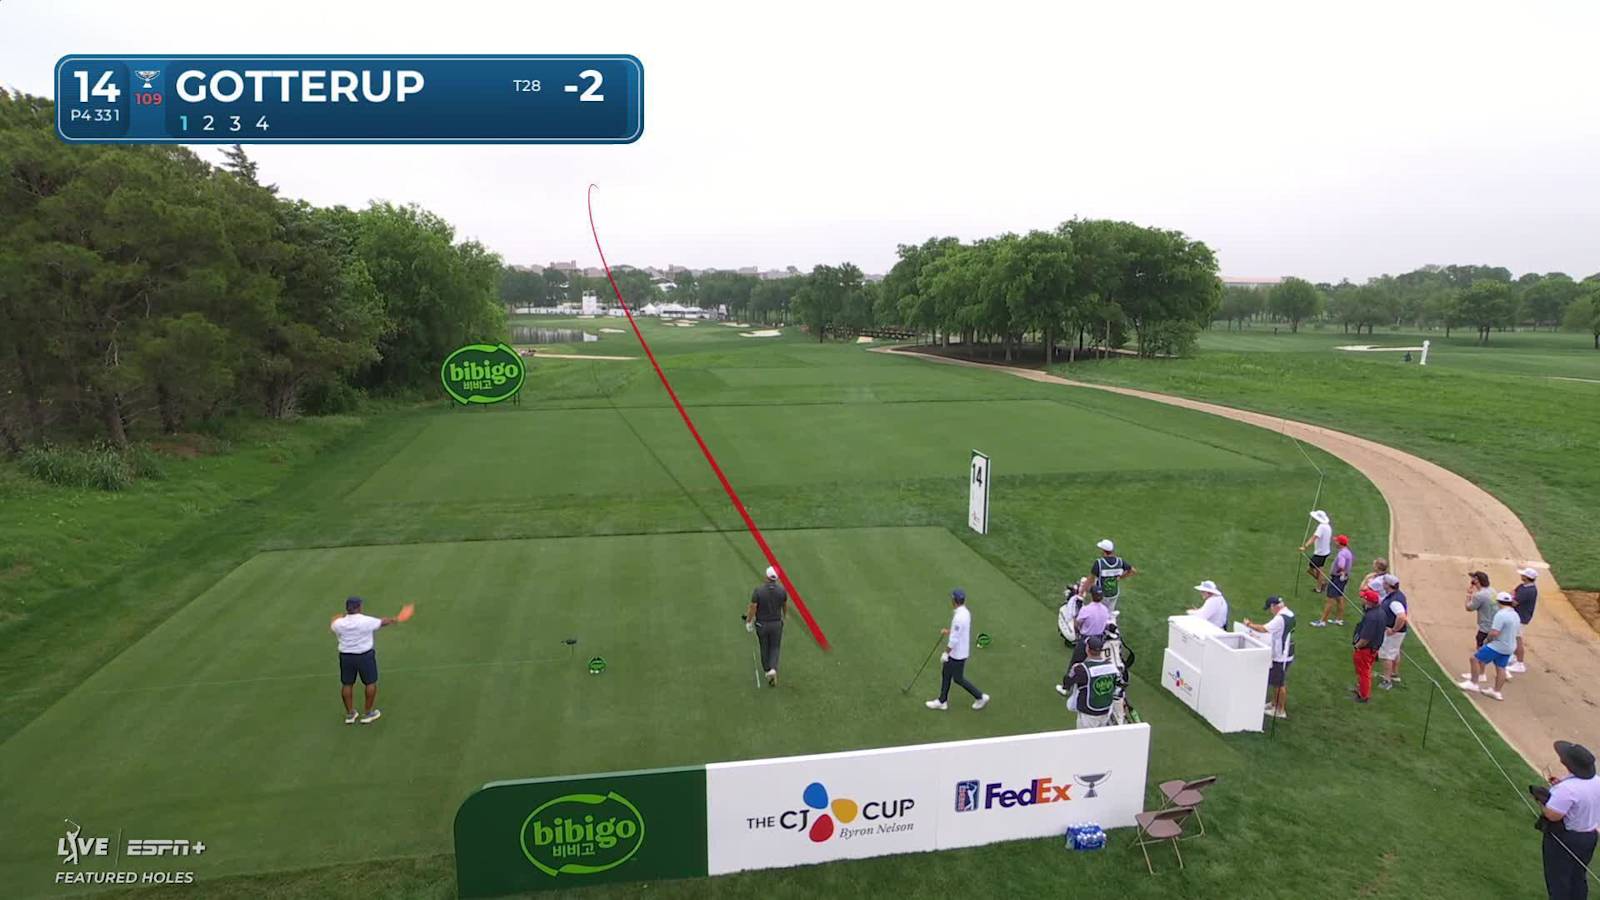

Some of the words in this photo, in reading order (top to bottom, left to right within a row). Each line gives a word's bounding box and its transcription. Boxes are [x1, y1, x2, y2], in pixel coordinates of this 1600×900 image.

[449, 359, 519, 385] bibigo
[464, 380, 492, 391] 비비고
[971, 463, 983, 487] 14
[984, 778, 1073, 809] FedEx
[746, 815, 776, 830] THE
[779, 809, 811, 832] CJ
[862, 799, 916, 821] CUP
[533, 815, 636, 849] bibigo
[839, 826, 874, 840] Byron
[876, 822, 914, 834] Nelson
[552, 842, 596, 858] 비비고
